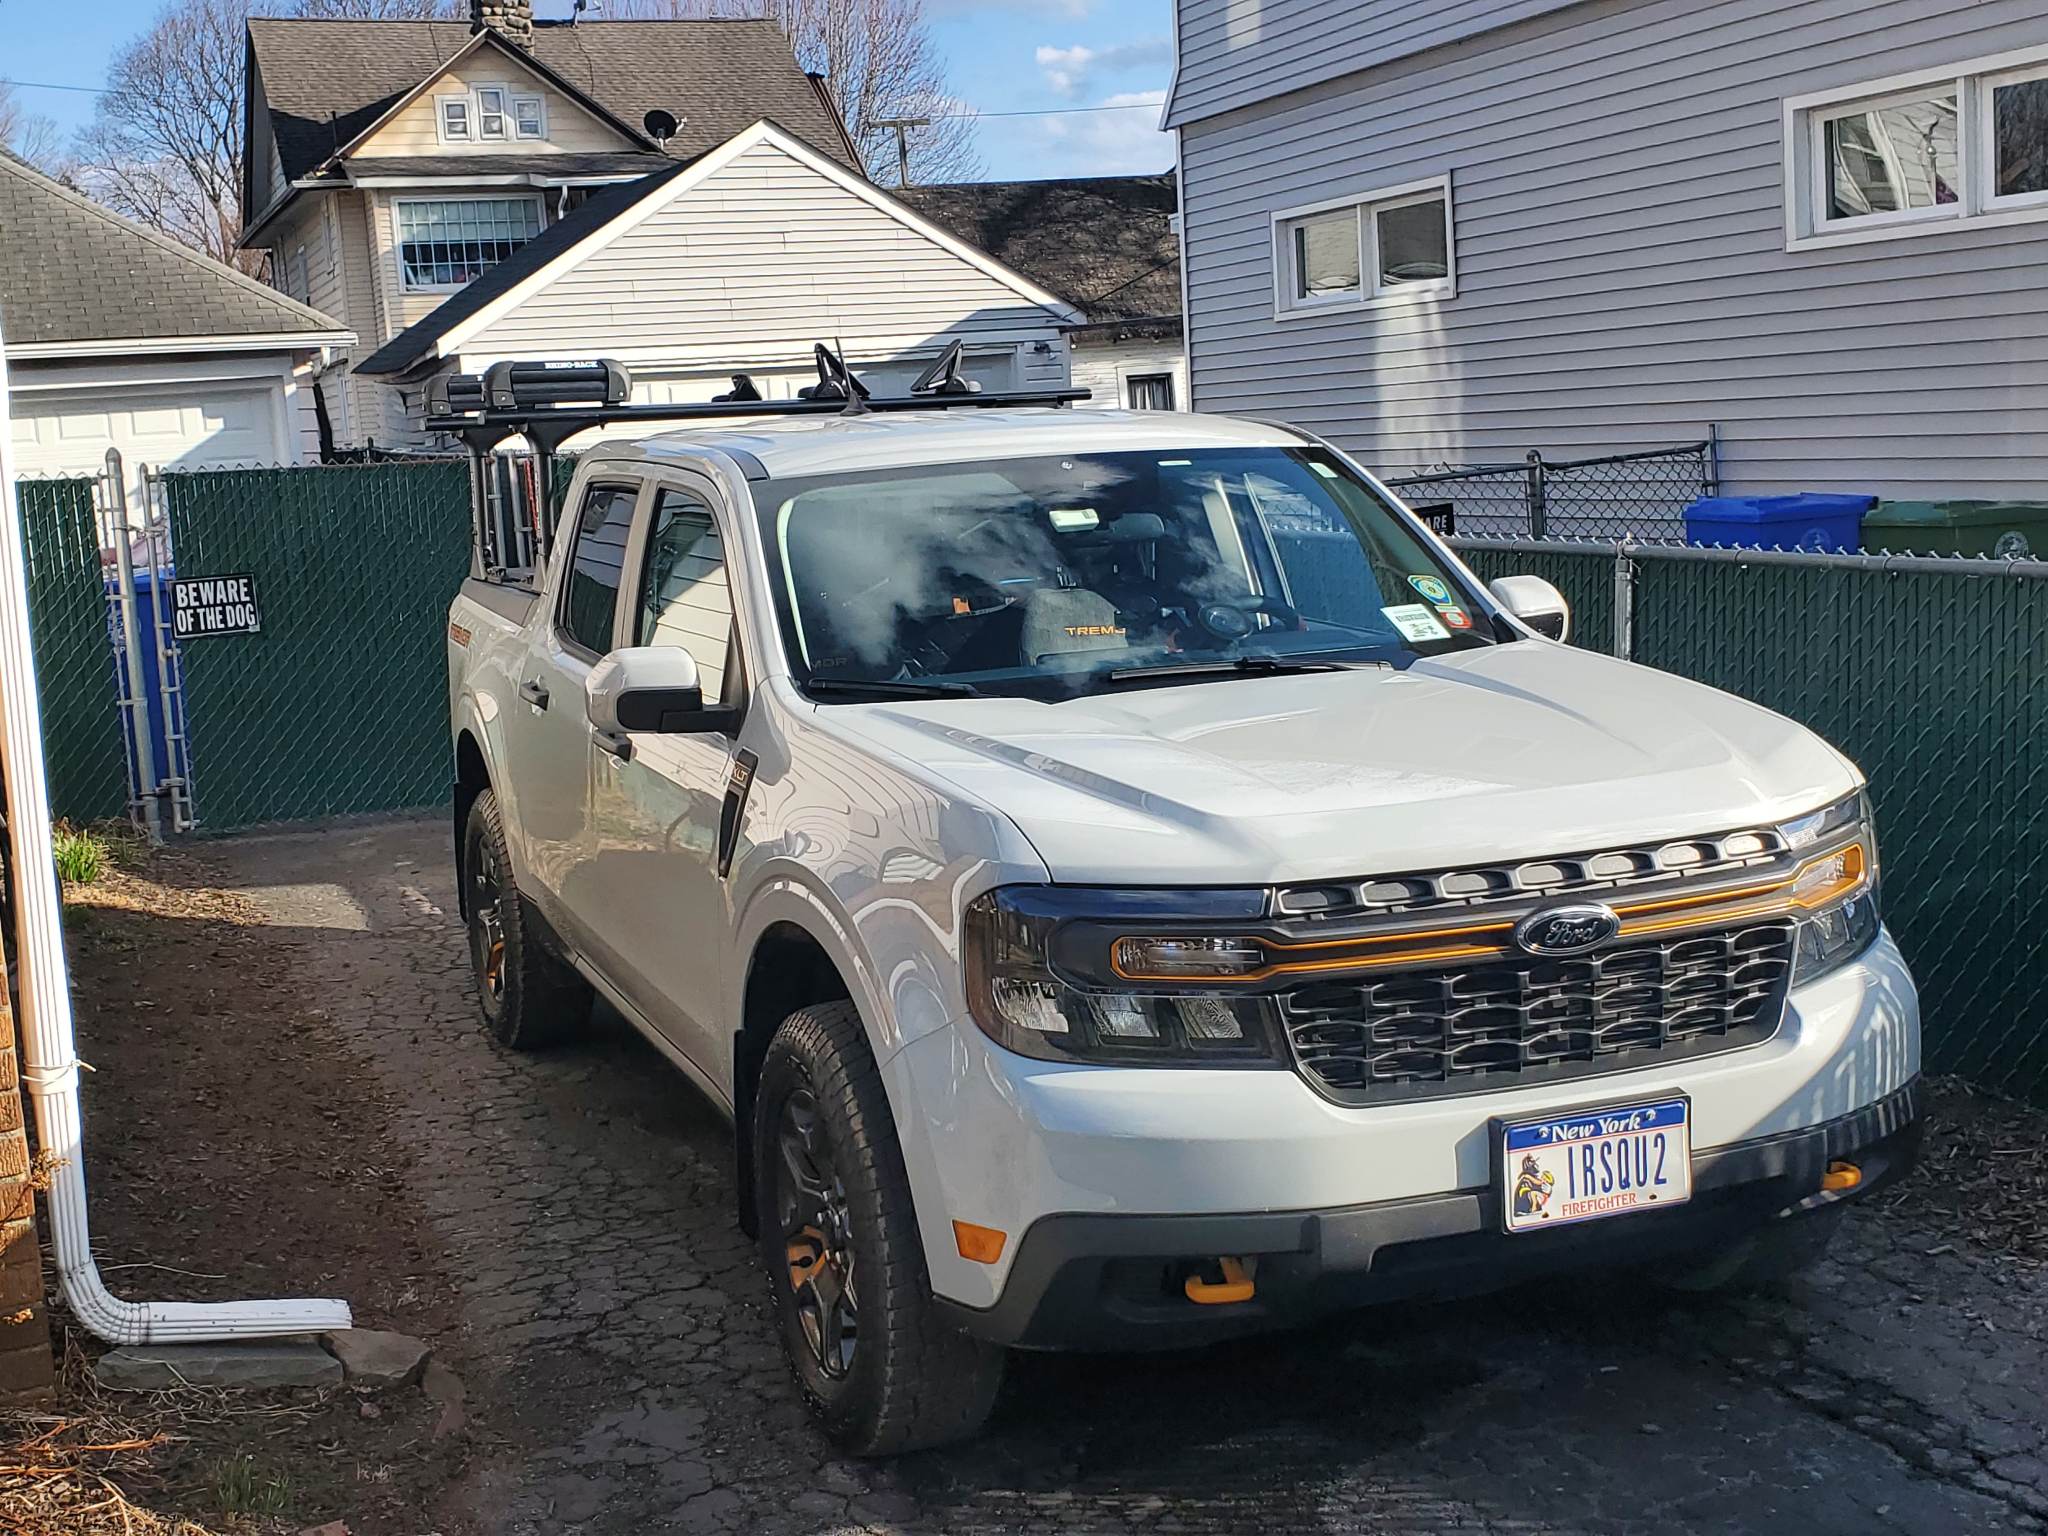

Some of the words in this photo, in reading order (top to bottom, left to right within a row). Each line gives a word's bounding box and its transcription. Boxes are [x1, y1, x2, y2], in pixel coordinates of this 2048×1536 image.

[1421, 514, 1448, 530] ARE
[175, 579, 251, 608] BEWARE
[176, 609, 195, 633] OF
[196, 606, 226, 631] THE
[225, 603, 256, 628] DOG
[1544, 917, 1599, 946] Ford
[1551, 1123, 1595, 1143] New
[1598, 1111, 1641, 1135] York
[1561, 1192, 1637, 1216] FIREFIGHTER
